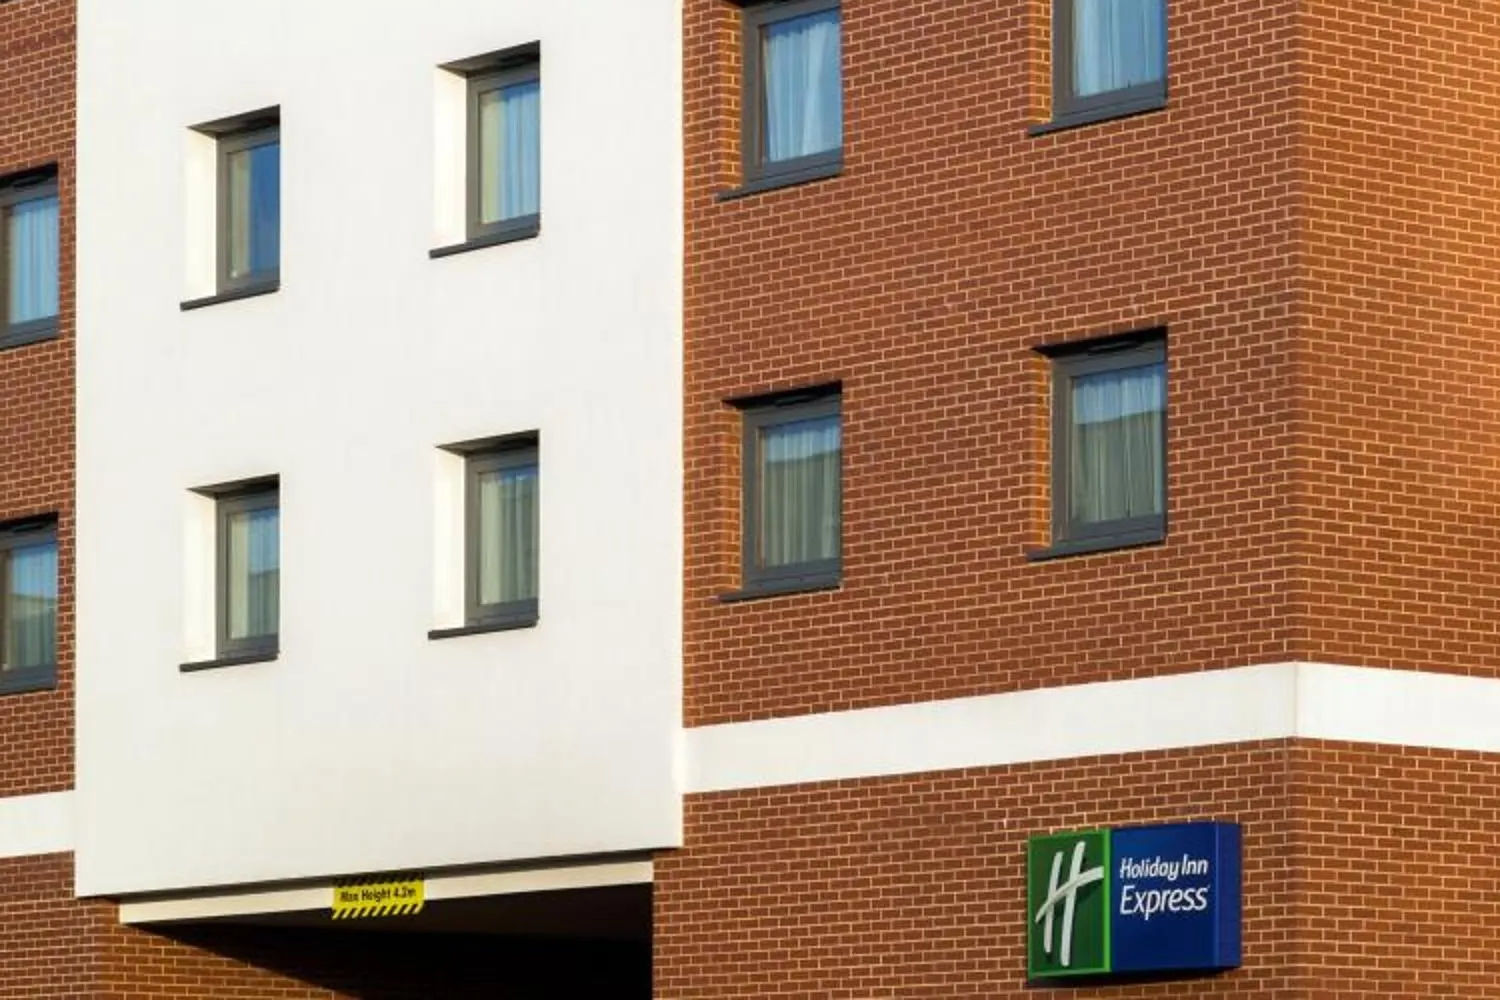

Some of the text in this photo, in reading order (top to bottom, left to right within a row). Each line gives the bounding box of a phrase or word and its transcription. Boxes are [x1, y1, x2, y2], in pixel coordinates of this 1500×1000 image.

[1119, 853, 1209, 881] Holiday Inn
[361, 886, 392, 903] Height
[1119, 885, 1209, 921] Express
